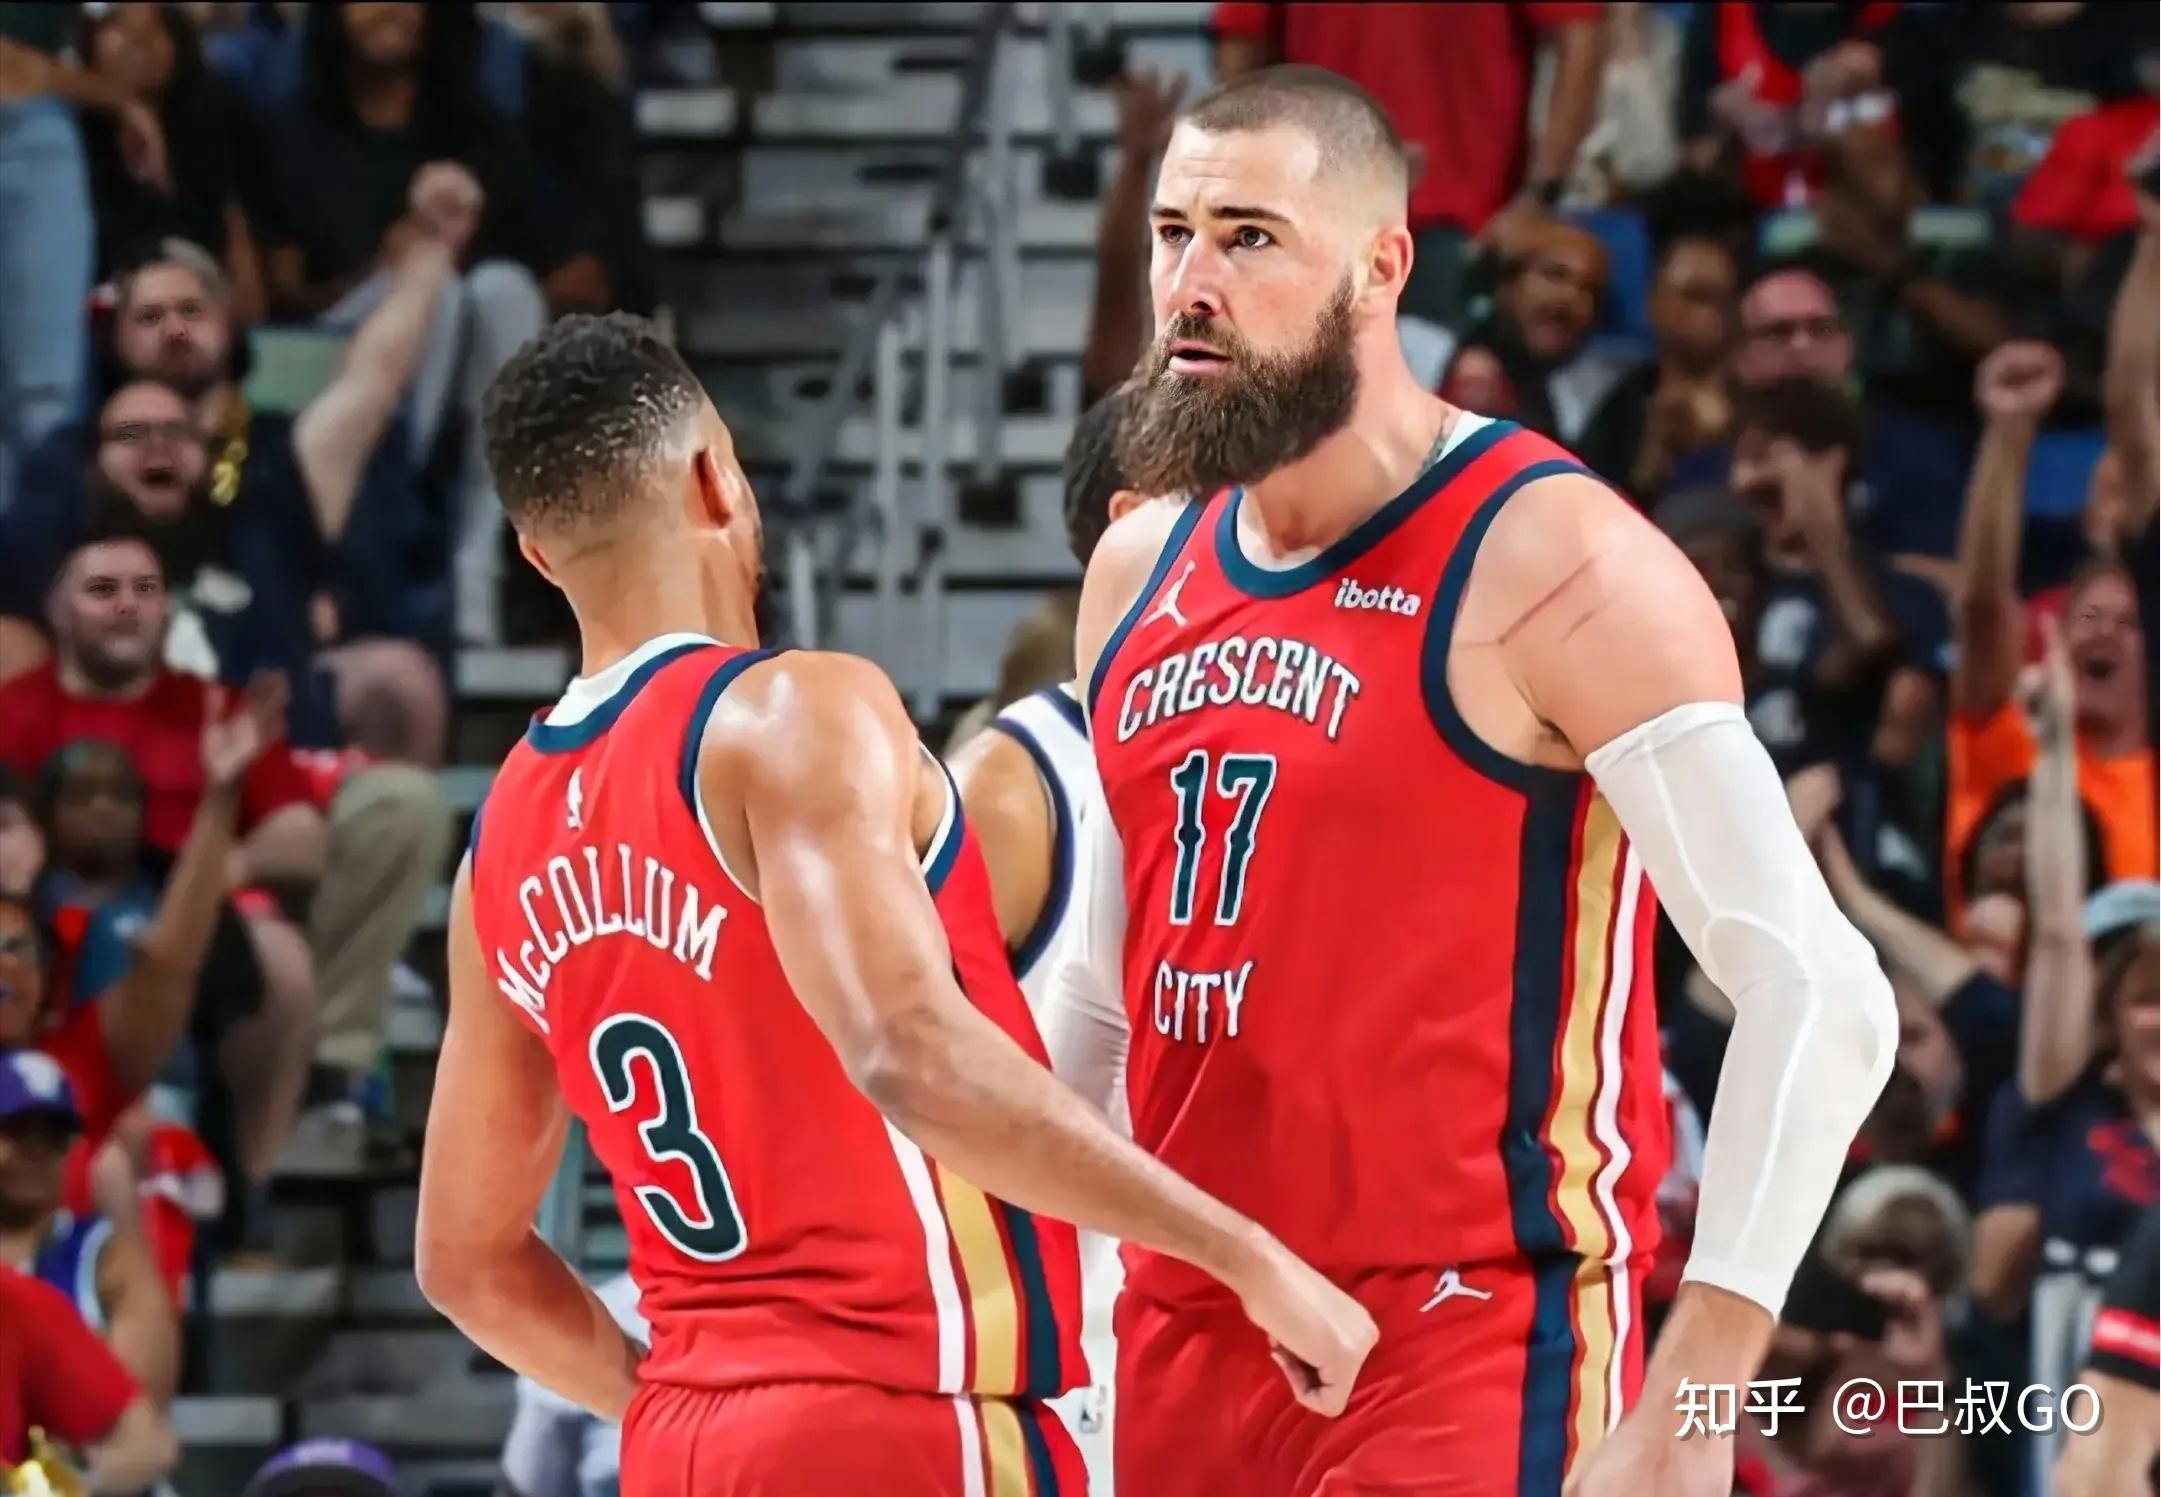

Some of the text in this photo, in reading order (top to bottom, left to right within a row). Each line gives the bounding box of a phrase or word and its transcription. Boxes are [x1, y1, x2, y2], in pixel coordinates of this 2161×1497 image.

[1335, 578, 1421, 616] ibotta
[1117, 636, 1361, 743] CRESCENT
[1170, 749, 1277, 927] 17
[497, 843, 727, 1035] McCOLLUM
[1154, 960, 1254, 1042] CITY
[589, 1013, 747, 1262] 3
